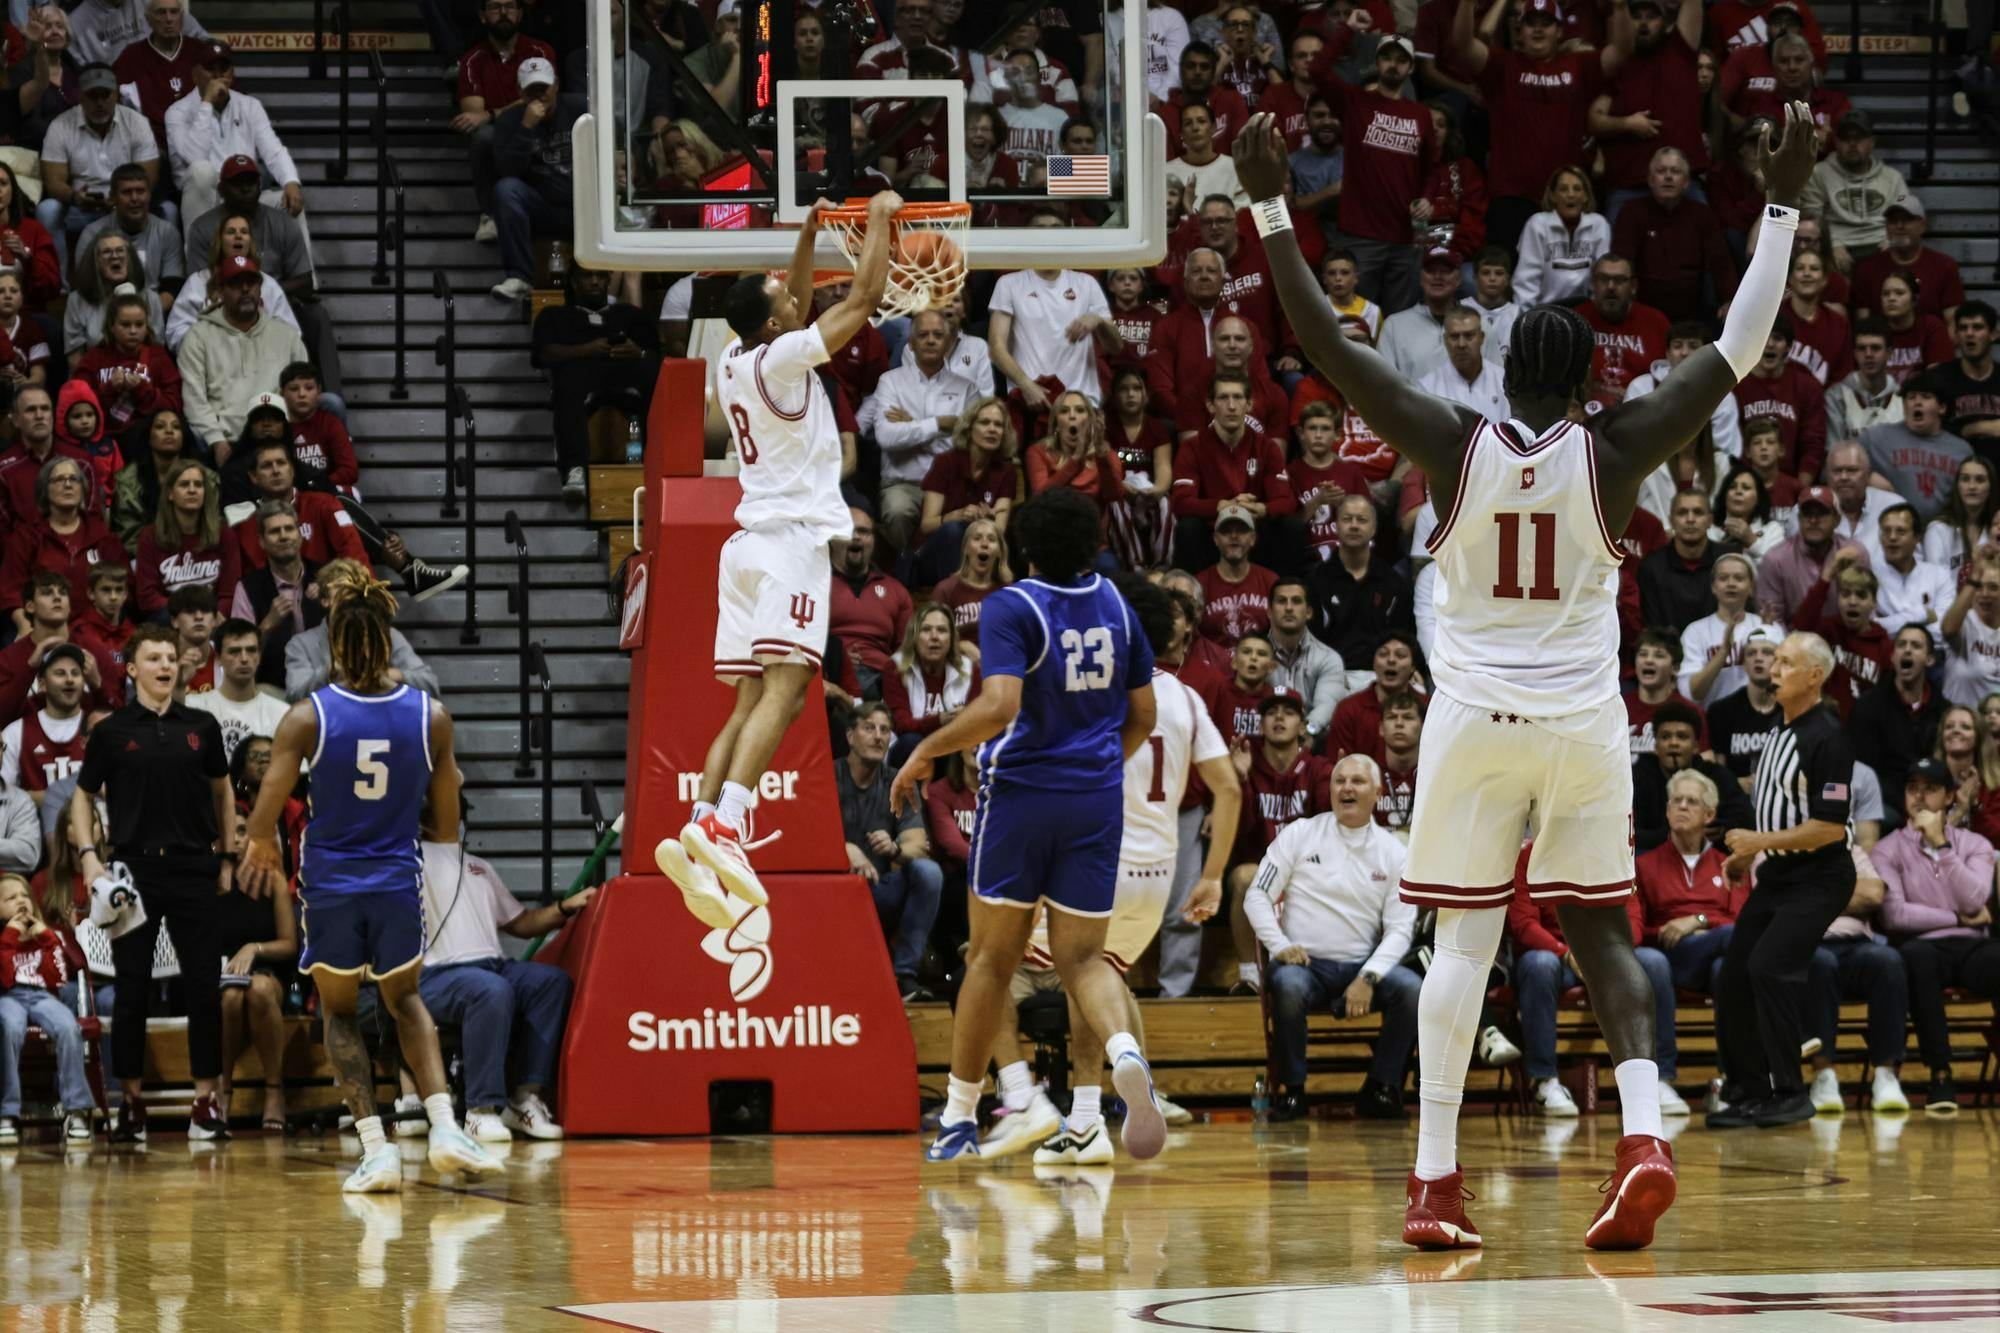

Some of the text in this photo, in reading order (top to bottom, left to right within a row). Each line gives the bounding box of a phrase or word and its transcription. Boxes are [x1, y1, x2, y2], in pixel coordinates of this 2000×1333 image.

[227, 34, 287, 48] WATCH
[1372, 110, 1418, 135] INDIANA
[1003, 128, 1054, 155] NDIANA
[1363, 124, 1421, 155] HOOSIERS
[1264, 198, 1285, 232] FAITH
[1219, 271, 1262, 298] SIERS
[1594, 331, 1645, 357] DIANA
[1789, 339, 1830, 386] IANA
[1744, 398, 1797, 421] INDIANA
[730, 403, 758, 465] 8
[295, 443, 323, 460] IANA
[1891, 447, 1958, 476] INDIANA
[160, 551, 221, 590] Indiana
[1493, 512, 1560, 601] 11
[1207, 592, 1269, 617] INDIANA
[1060, 627, 1115, 692] 23
[353, 739, 391, 800] 5
[1147, 736, 1166, 802] 1
[678, 770, 799, 809] mer
[628, 1005, 860, 1051] Smithville
